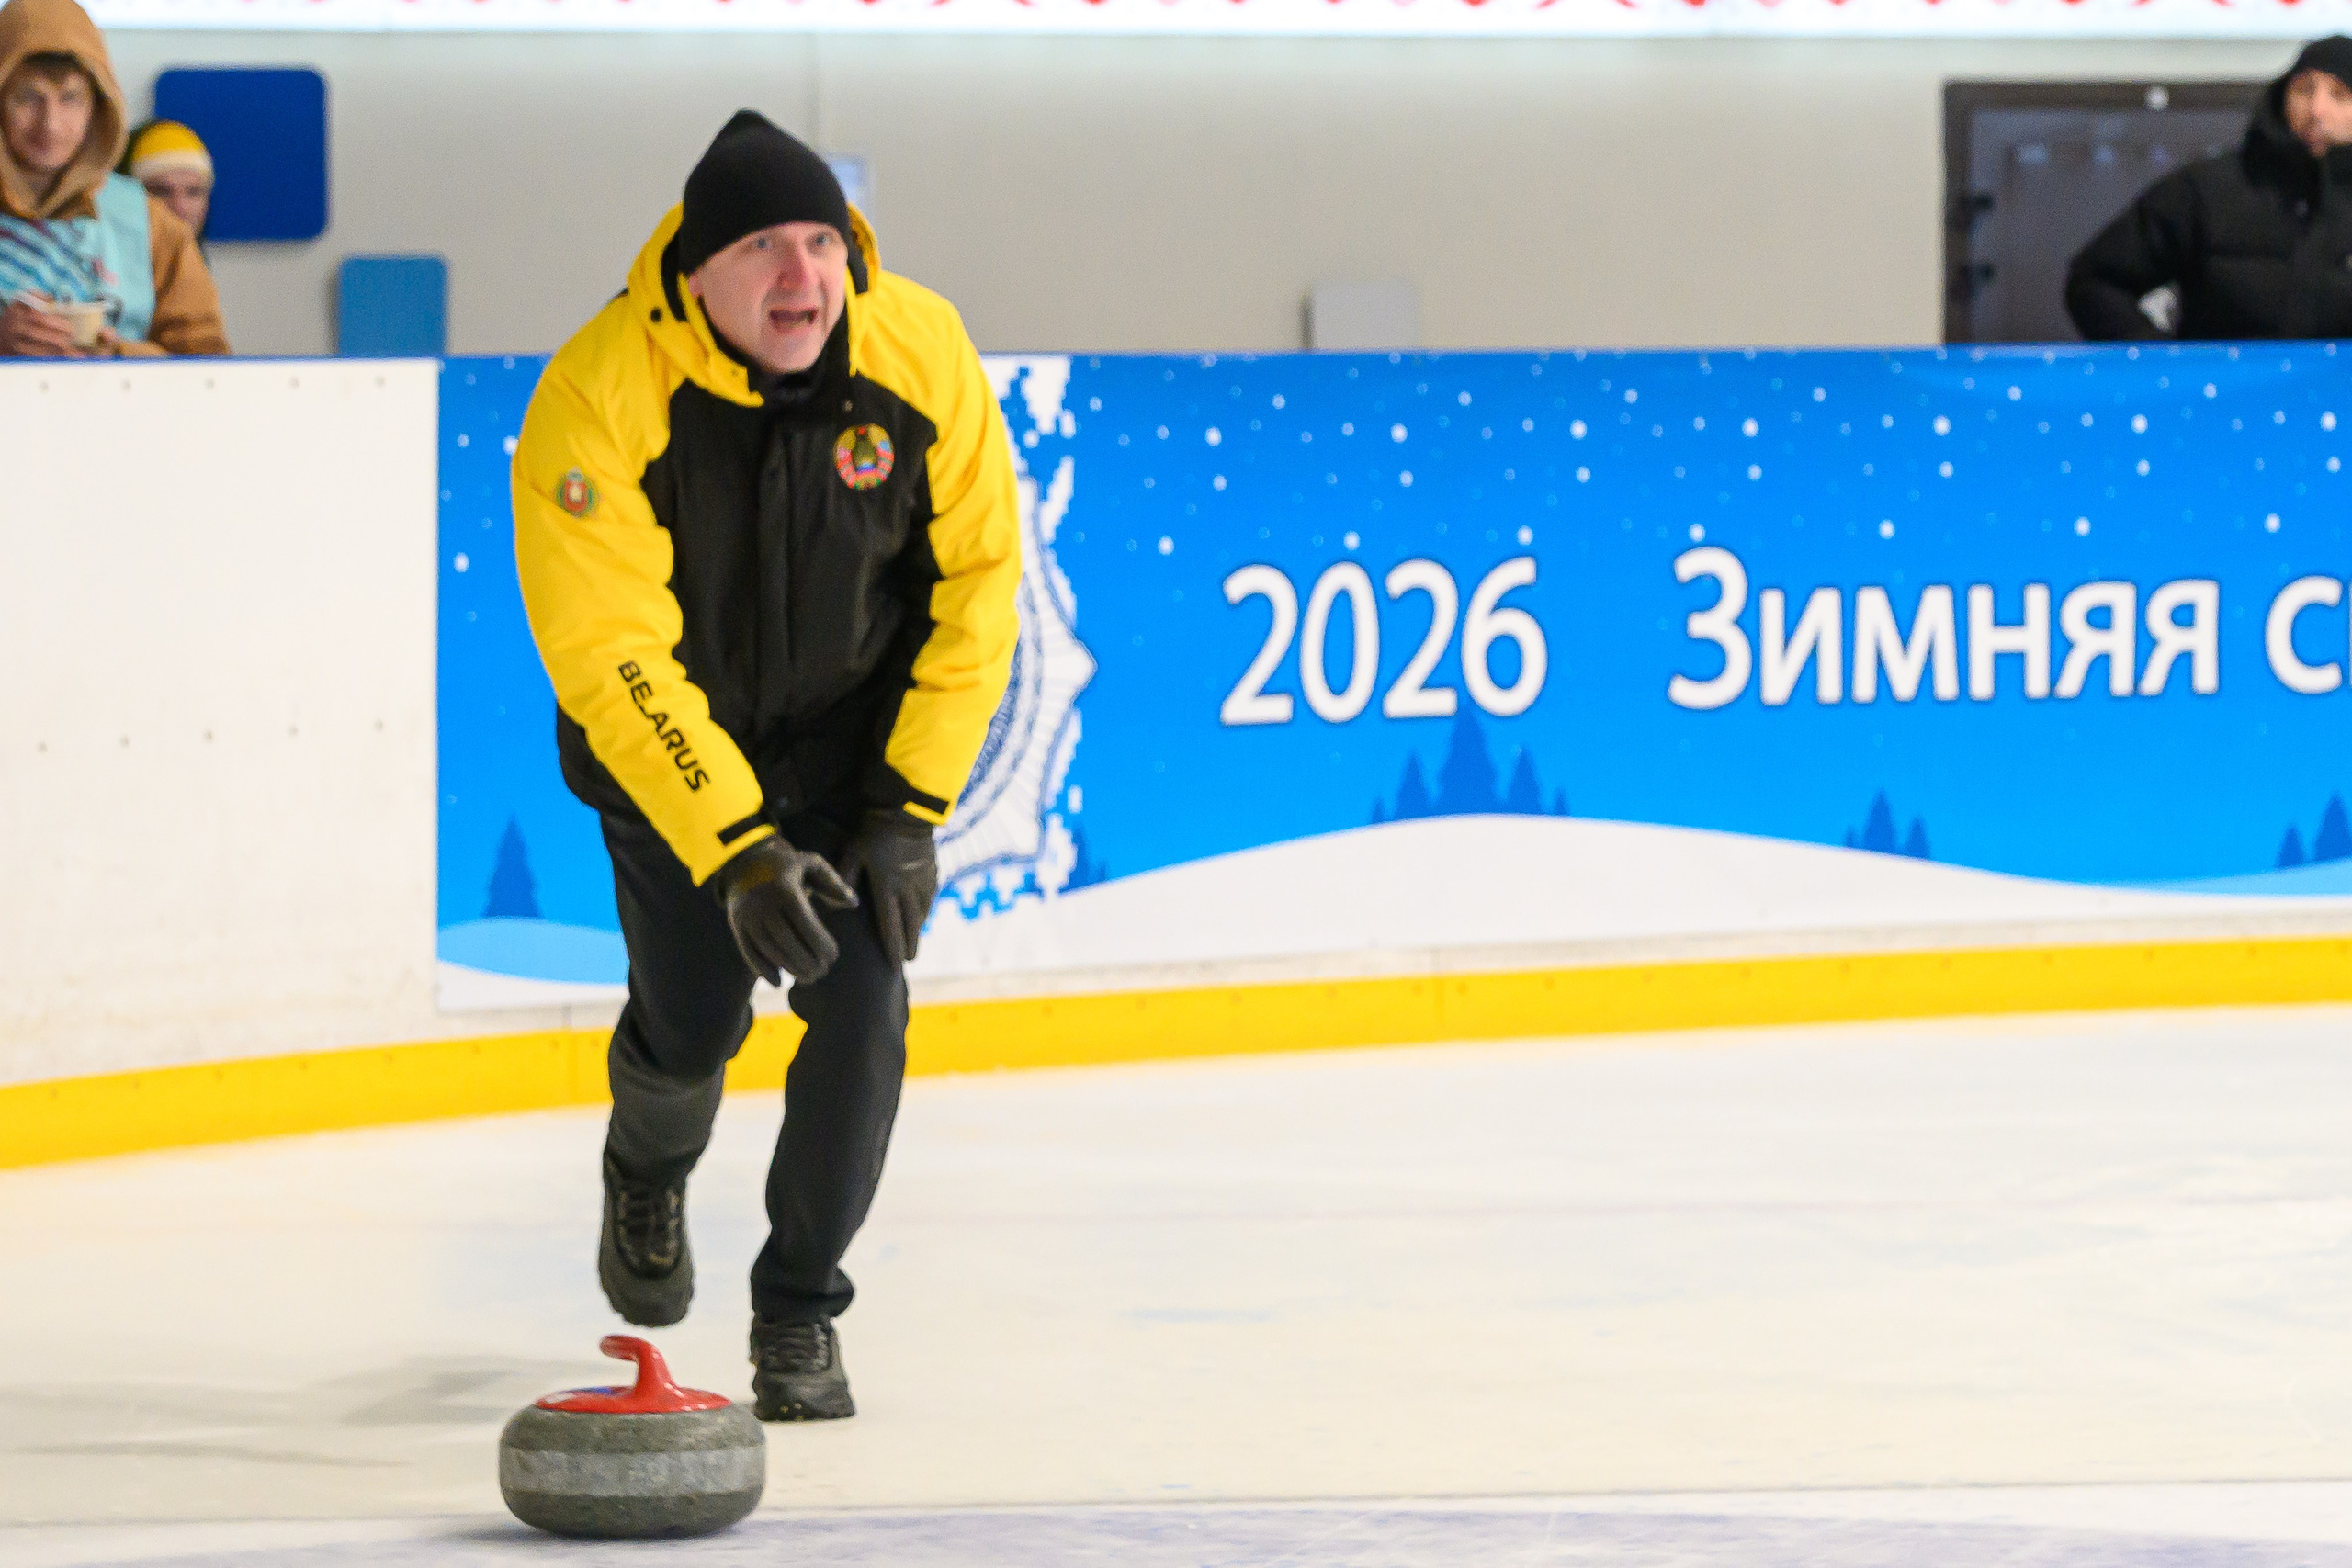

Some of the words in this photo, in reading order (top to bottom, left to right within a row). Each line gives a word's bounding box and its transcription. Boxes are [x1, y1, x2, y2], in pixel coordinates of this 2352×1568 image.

[1219, 556, 1548, 727] 2026
[1668, 546, 2221, 710] Зимняя
[2265, 575, 2352, 695] с
